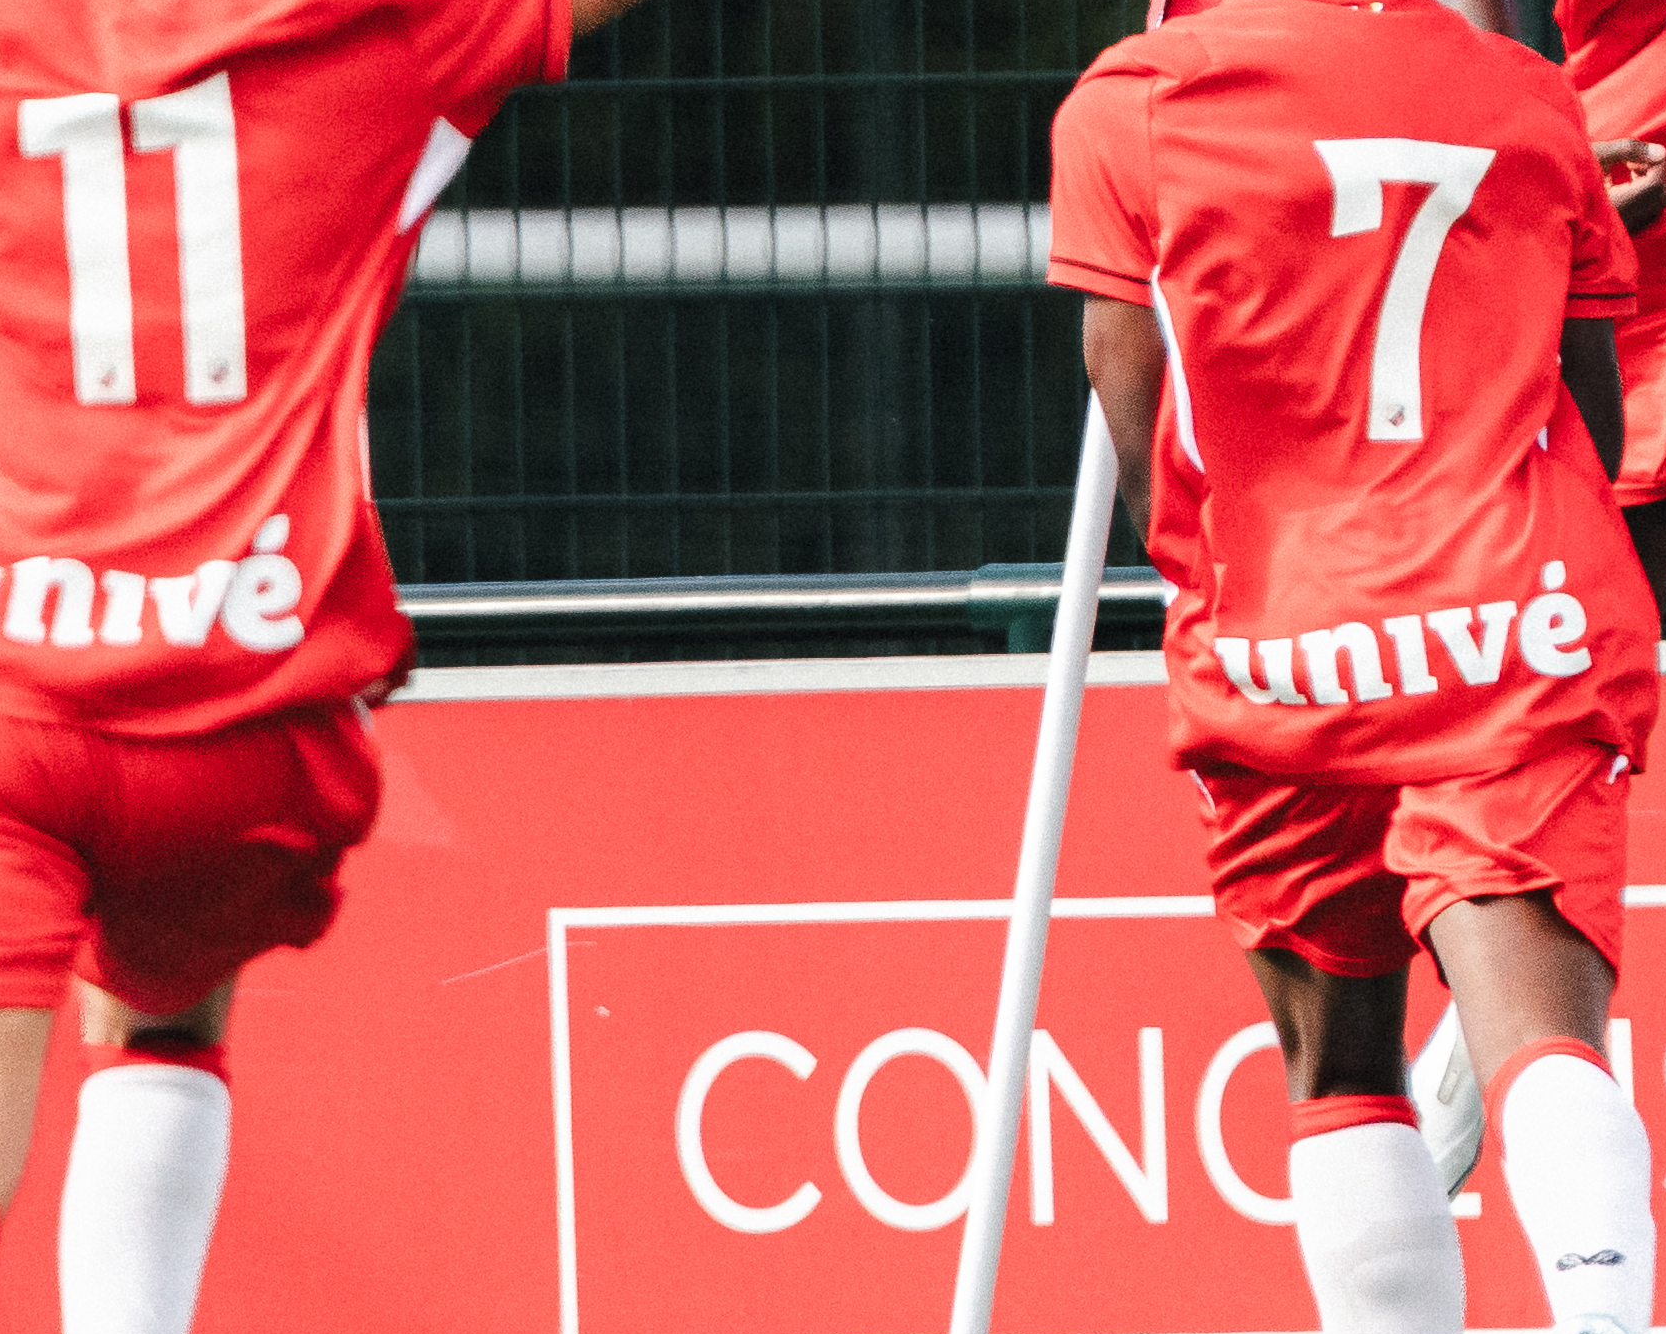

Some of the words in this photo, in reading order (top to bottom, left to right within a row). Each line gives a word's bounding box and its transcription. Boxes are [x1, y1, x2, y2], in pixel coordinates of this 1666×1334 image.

[16, 70, 248, 406] 11
[1312, 137, 1498, 442] 7
[1213, 560, 1593, 707] univé
